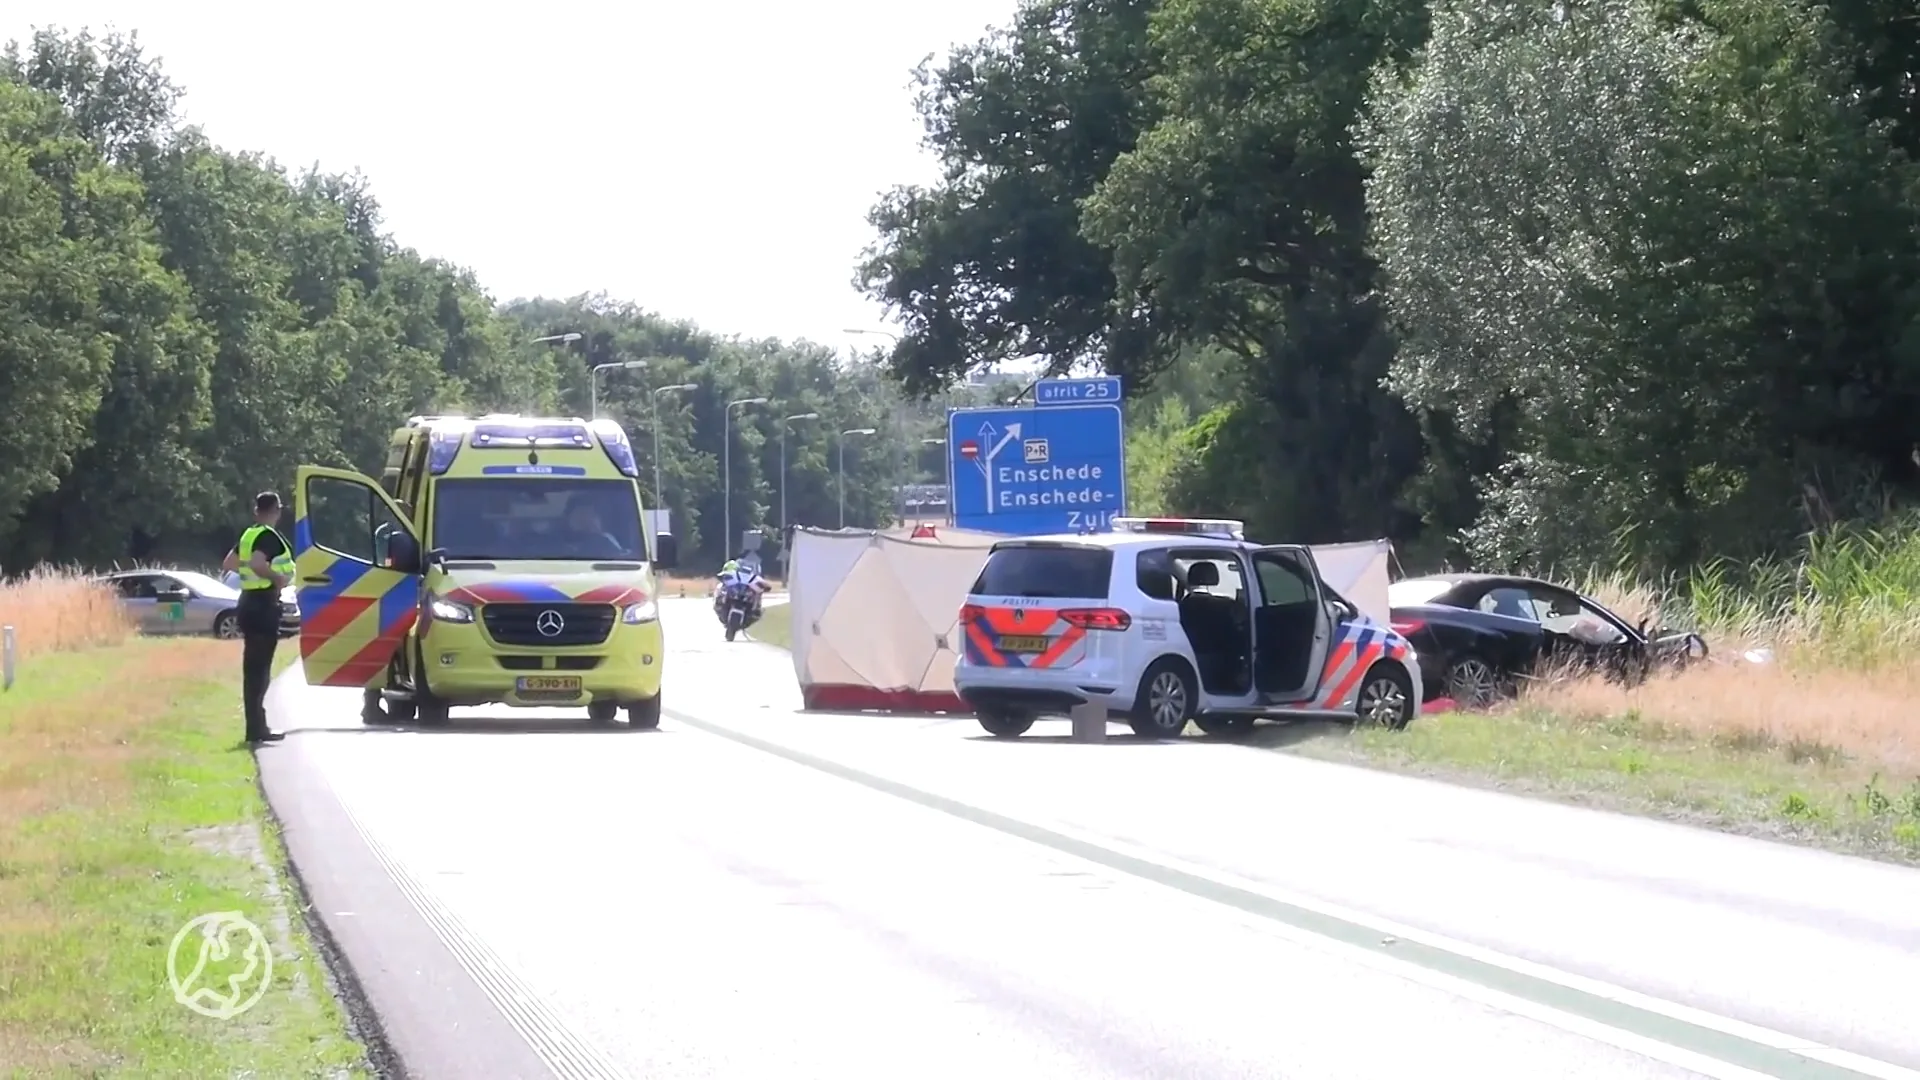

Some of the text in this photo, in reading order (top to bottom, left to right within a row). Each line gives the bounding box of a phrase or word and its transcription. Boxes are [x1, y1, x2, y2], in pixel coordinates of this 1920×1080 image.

[1044, 383, 1109, 397] afrit 25
[1025, 445, 1048, 457] P+R
[999, 464, 1102, 483] Enschede
[1000, 487, 1116, 506] Enschede-
